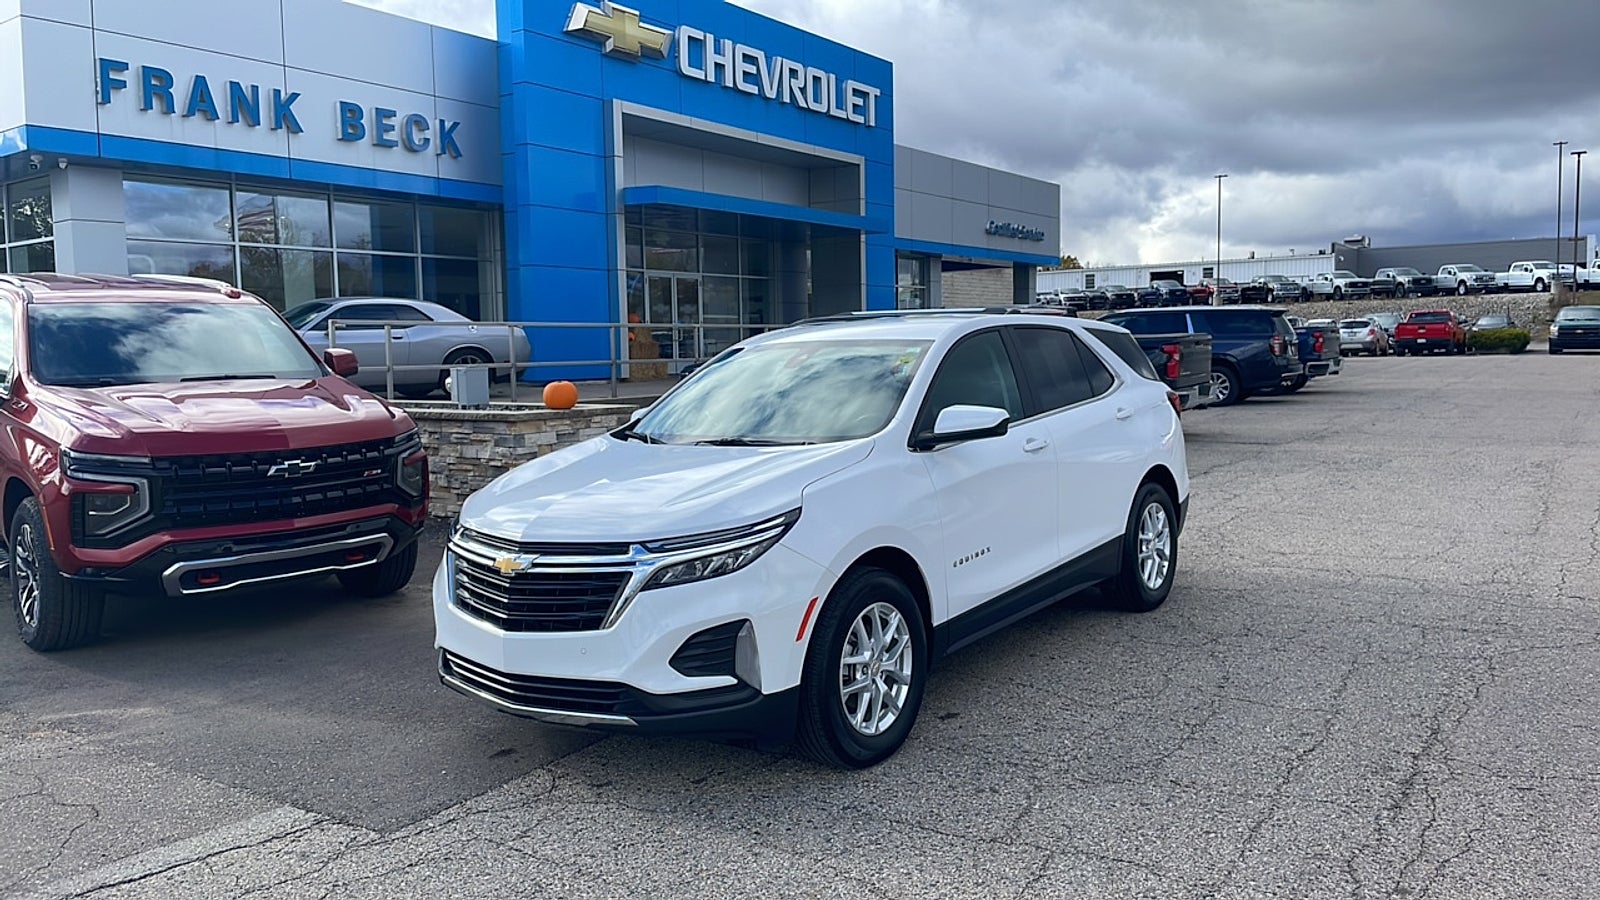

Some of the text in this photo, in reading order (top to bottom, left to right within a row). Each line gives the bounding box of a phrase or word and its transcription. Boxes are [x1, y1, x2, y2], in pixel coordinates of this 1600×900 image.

[97, 57, 463, 159] FRANK BECK
[675, 25, 880, 127] CHEVROLET
[952, 546, 991, 568] EQUINOX
